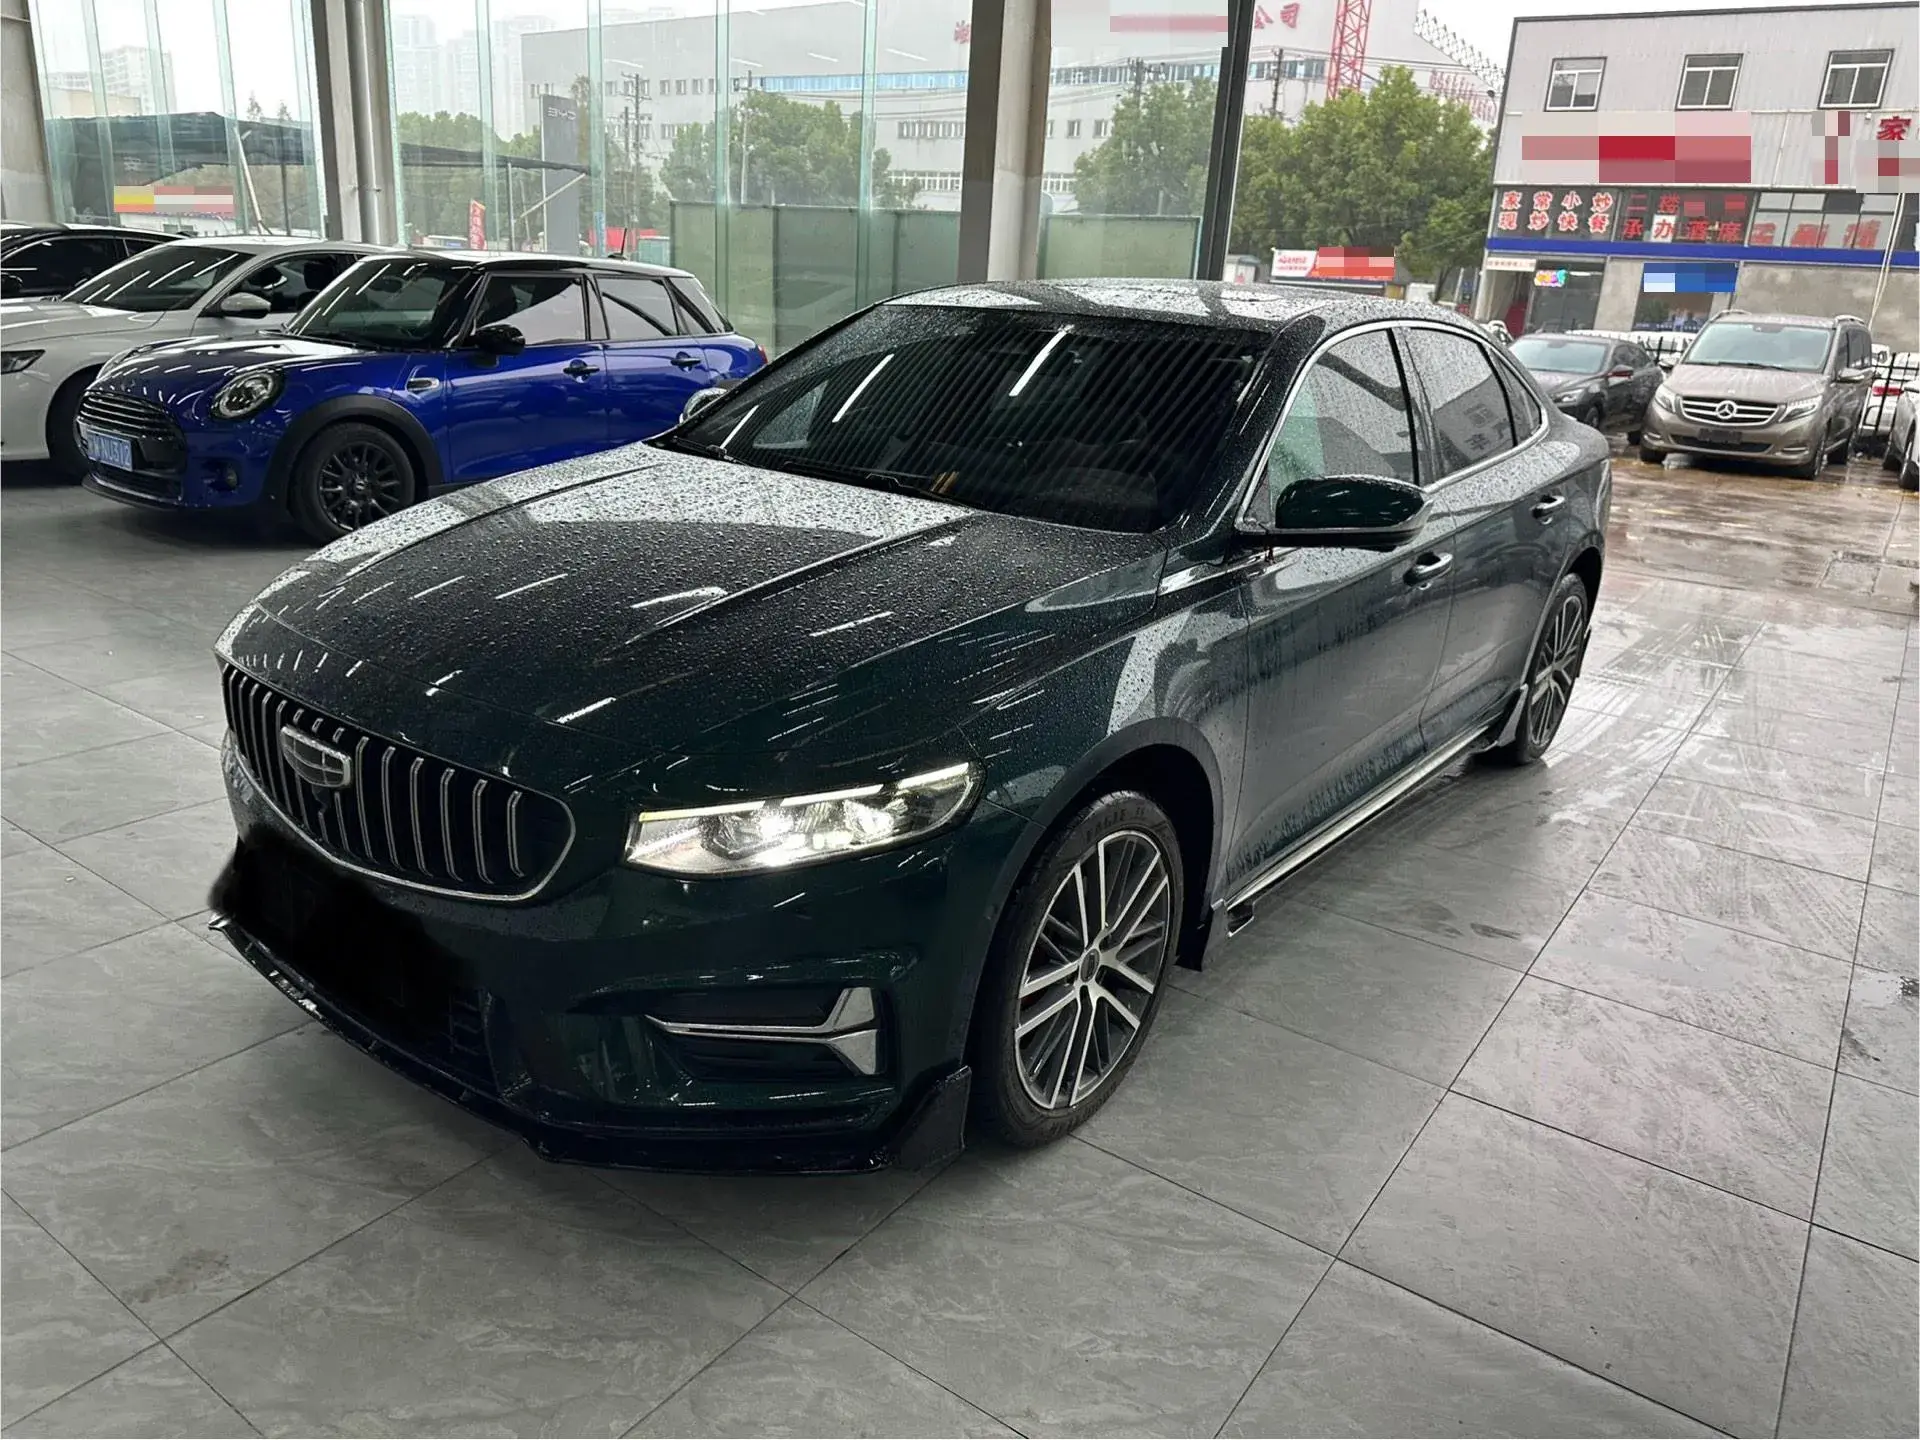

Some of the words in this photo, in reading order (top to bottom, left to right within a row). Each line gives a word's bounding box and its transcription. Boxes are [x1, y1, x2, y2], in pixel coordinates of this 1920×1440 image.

[1500, 191, 1614, 213] 家常小炒
[1498, 211, 1610, 234] 现炒快餐
